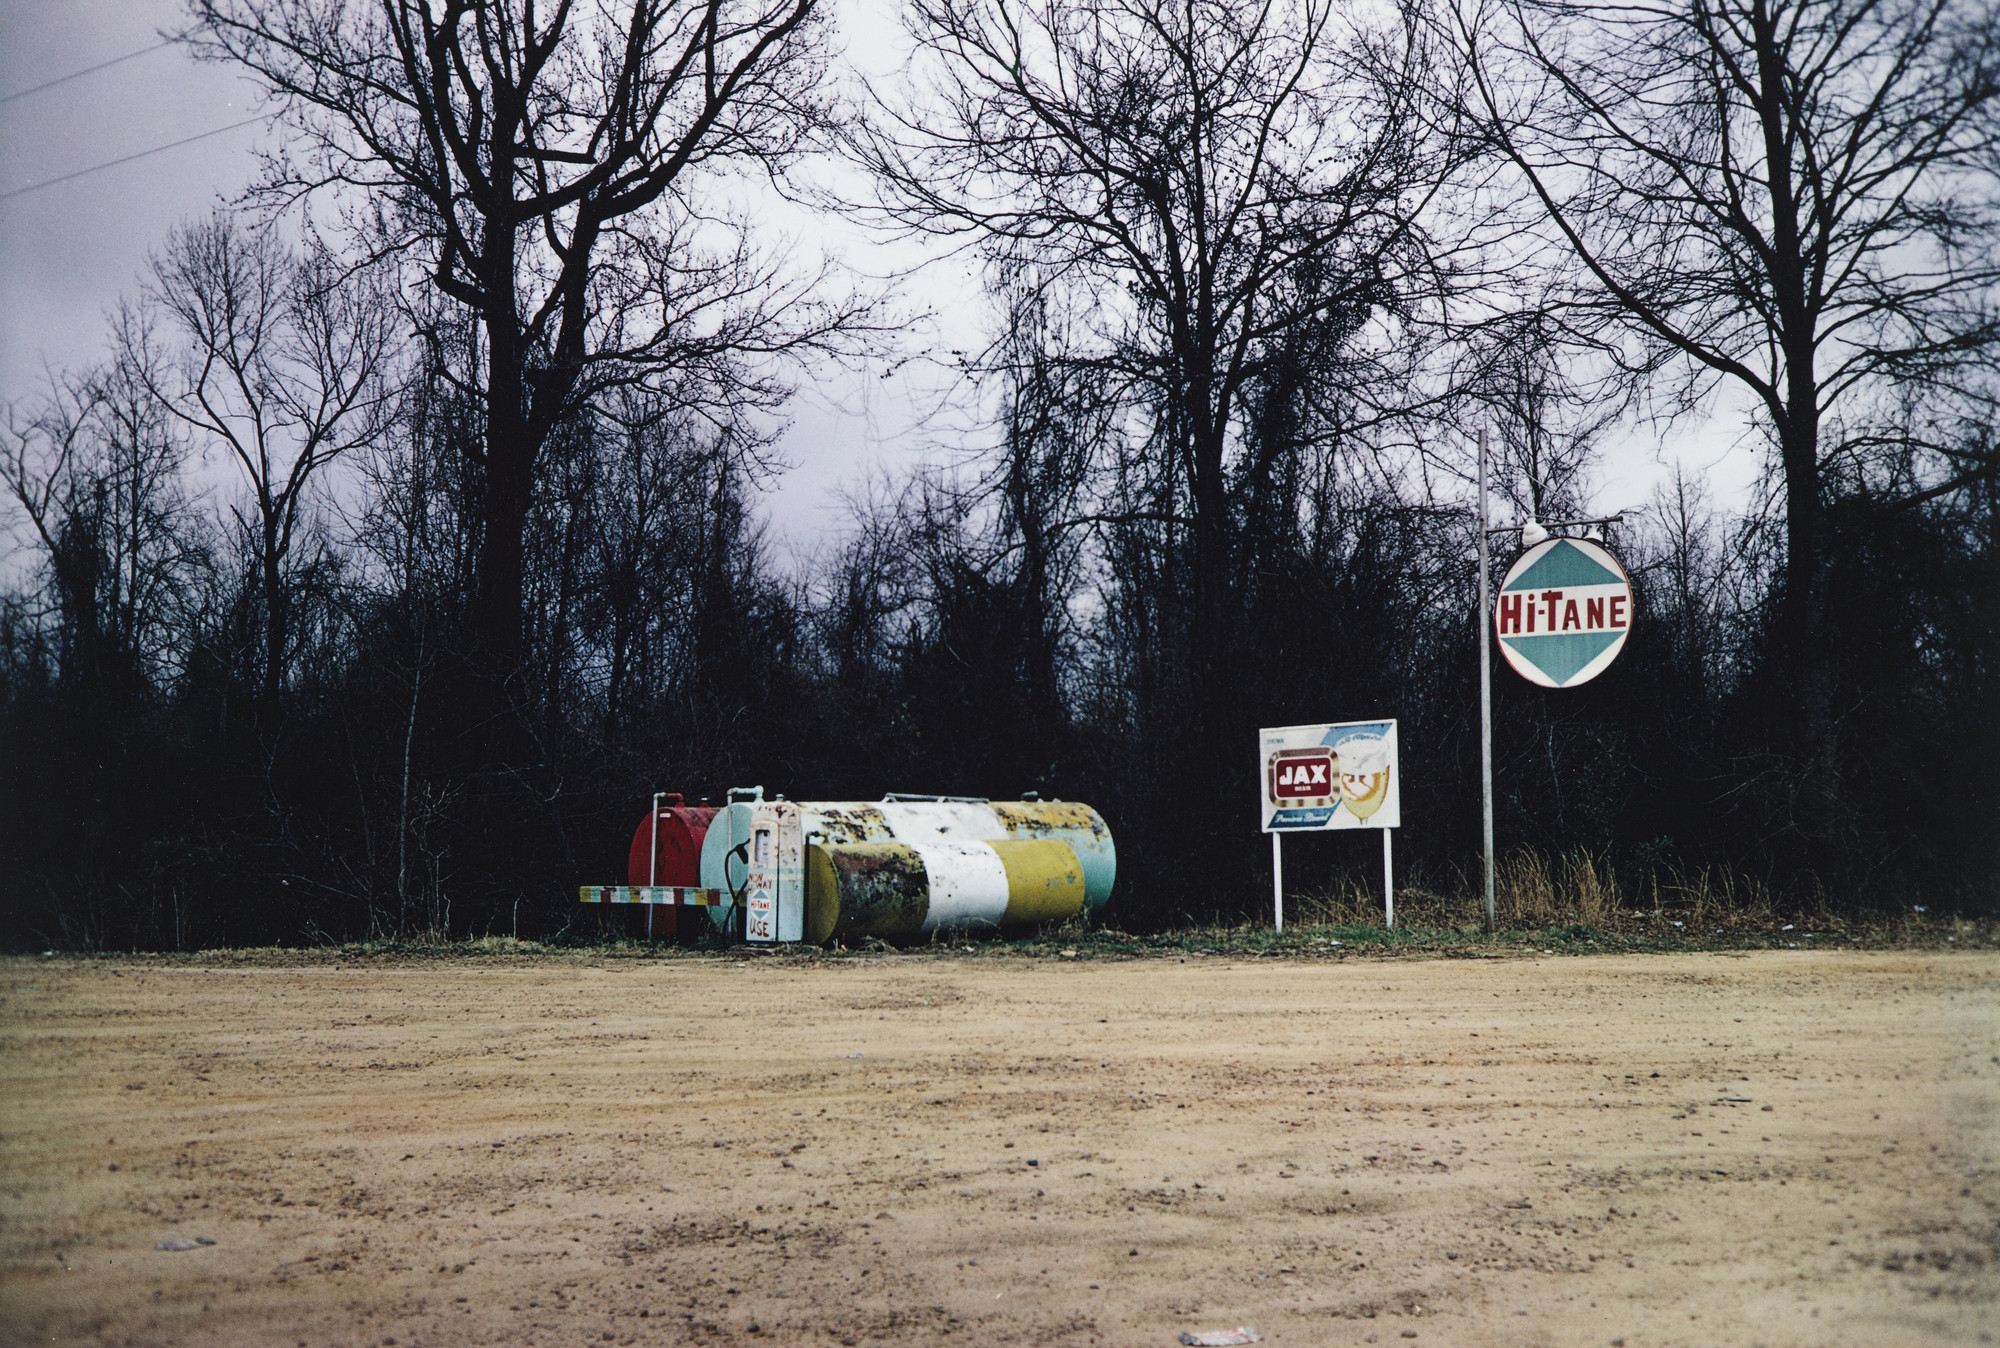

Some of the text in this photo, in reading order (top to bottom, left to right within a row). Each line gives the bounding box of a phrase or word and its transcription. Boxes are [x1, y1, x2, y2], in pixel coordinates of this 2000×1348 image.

[1500, 592, 1627, 634] Hi-TANE
[1279, 765, 1327, 785] JAX
[748, 873, 763, 882] NON
[756, 879, 772, 889] WAY
[750, 918, 769, 937] USE
